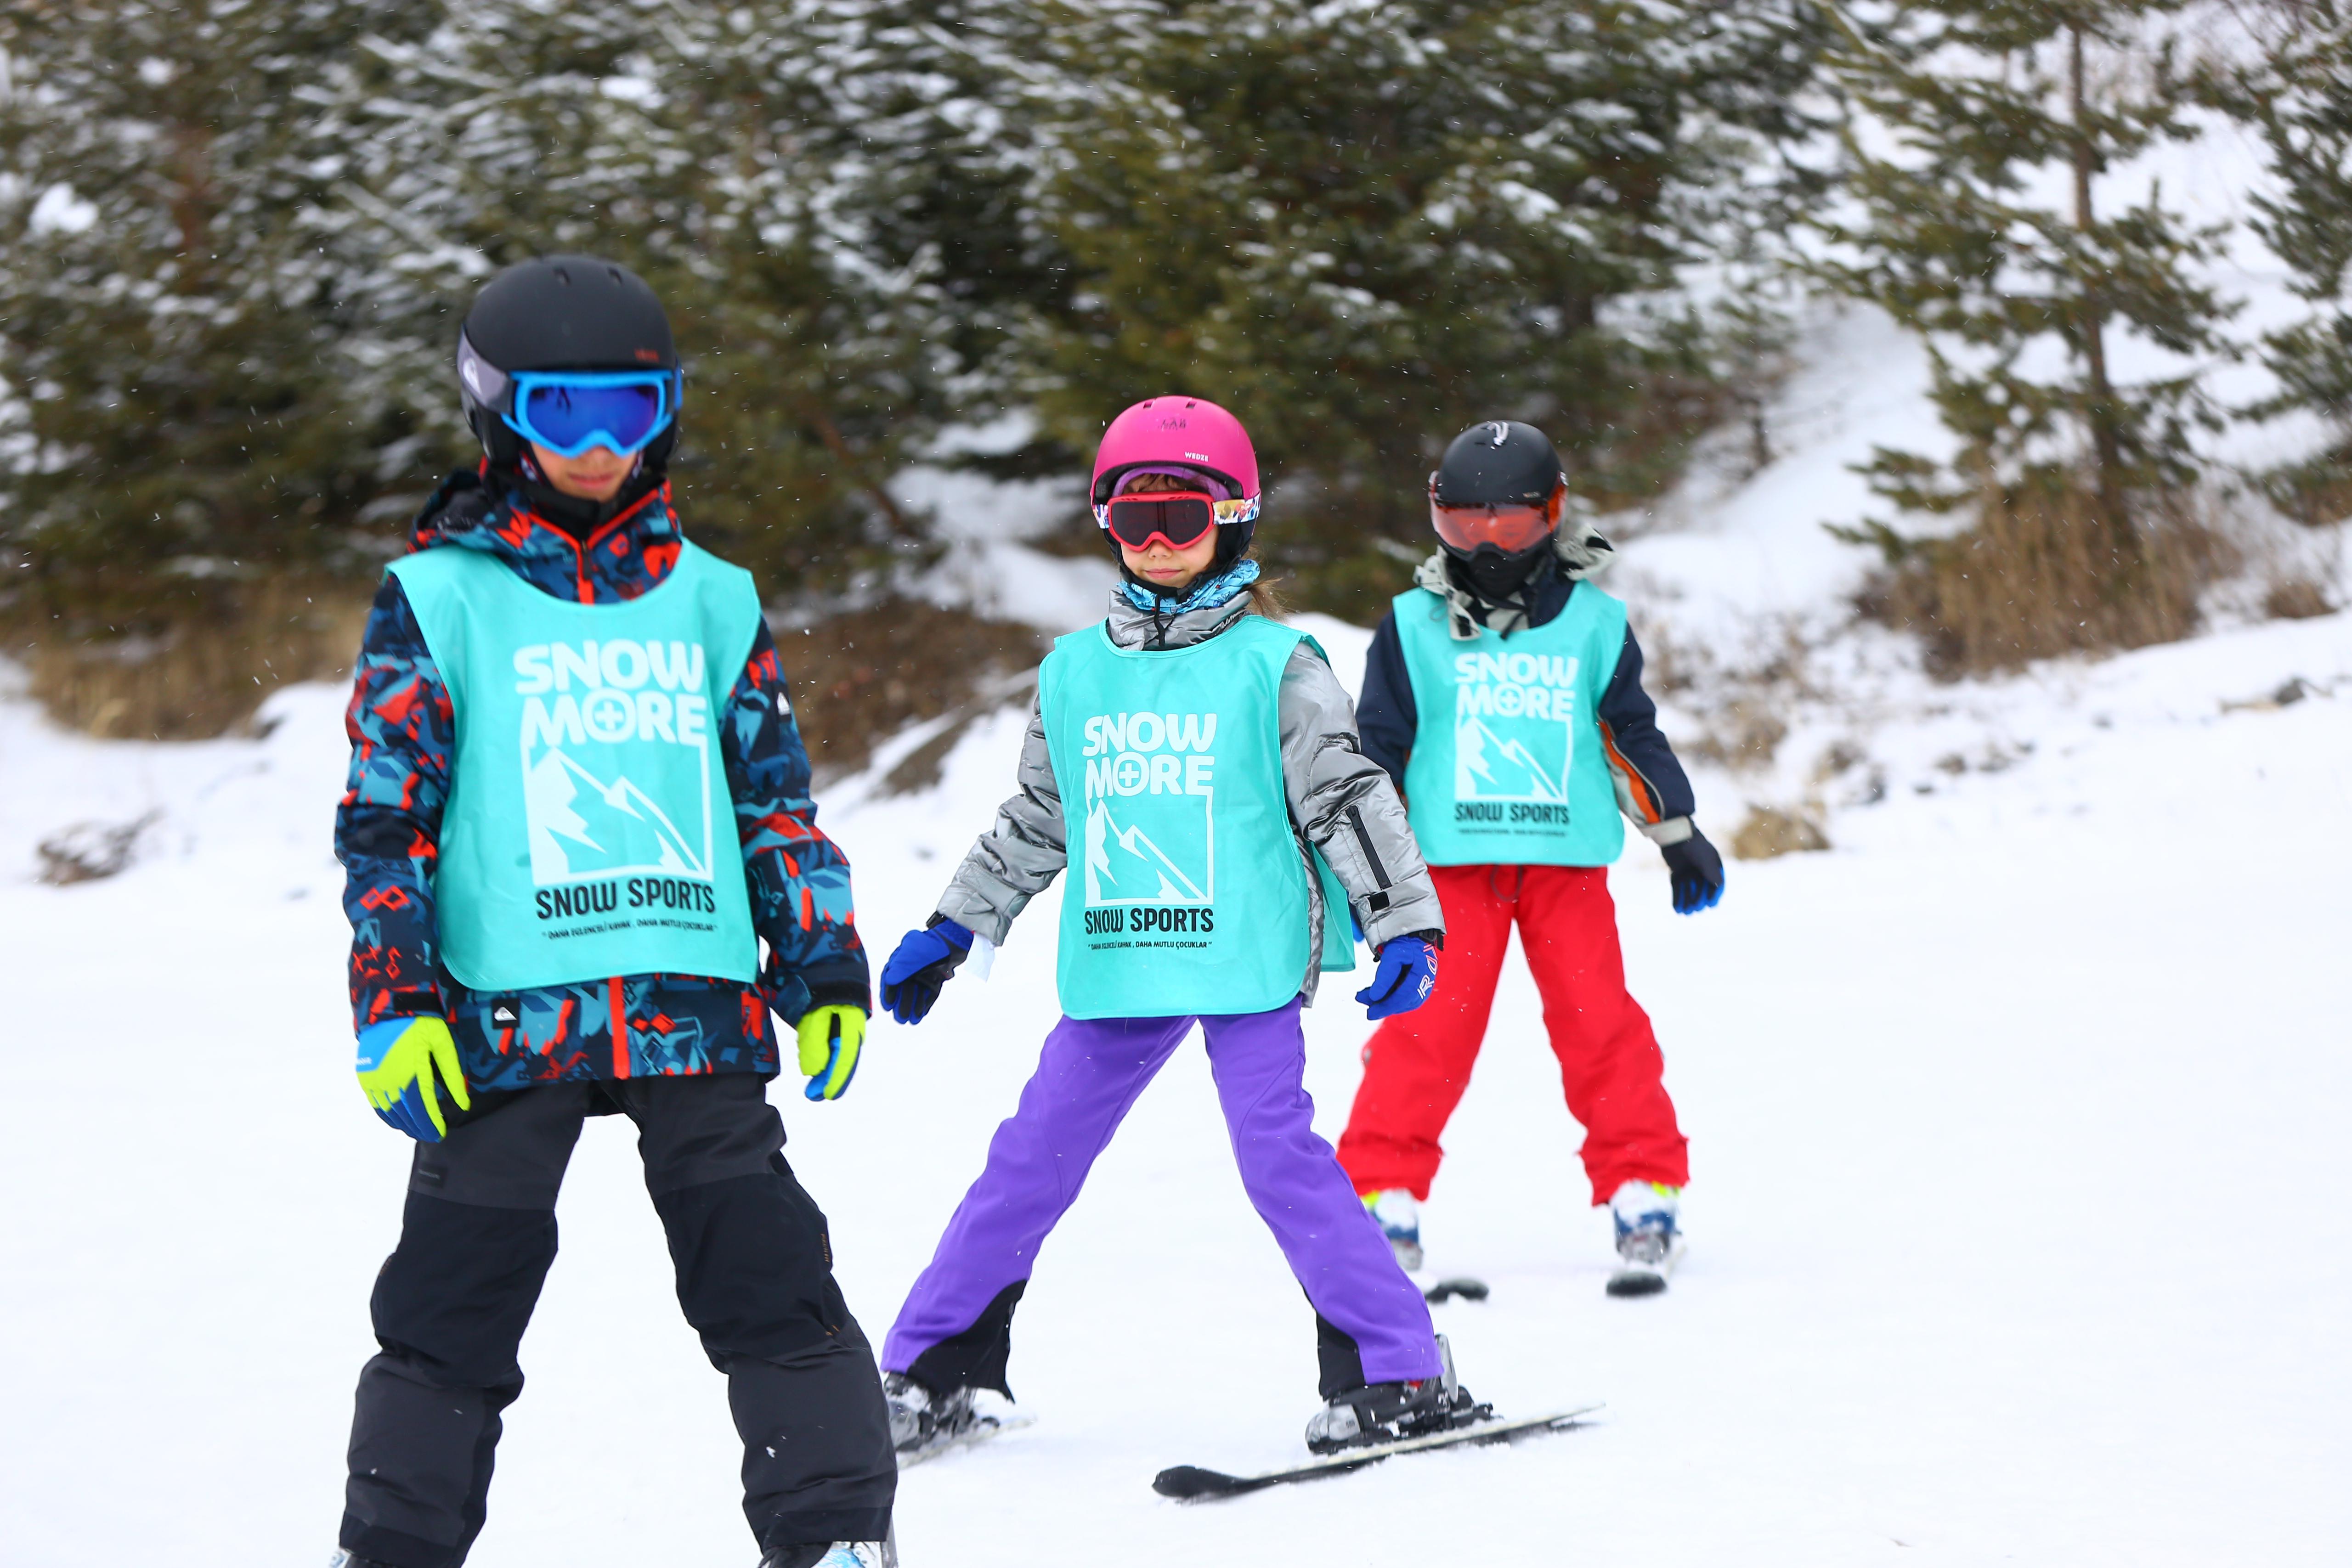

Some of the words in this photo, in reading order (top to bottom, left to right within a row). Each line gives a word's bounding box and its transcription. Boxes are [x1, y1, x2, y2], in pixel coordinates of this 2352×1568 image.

[1185, 451, 1209, 463] WEDZE
[513, 639, 705, 695] SNOW
[1454, 651, 1579, 688] SNOW
[520, 687, 707, 748] MORE
[1456, 682, 1576, 722] MORE
[1082, 711, 1217, 757] SNOW
[1085, 751, 1215, 798] MORE
[1454, 802, 1503, 822] SNOW
[1510, 803, 1570, 825] SPORTS
[535, 881, 617, 919] SNOW
[627, 878, 716, 913] SPORTS
[1085, 908, 1124, 935] SNOW
[1130, 908, 1214, 932] SPORTS
